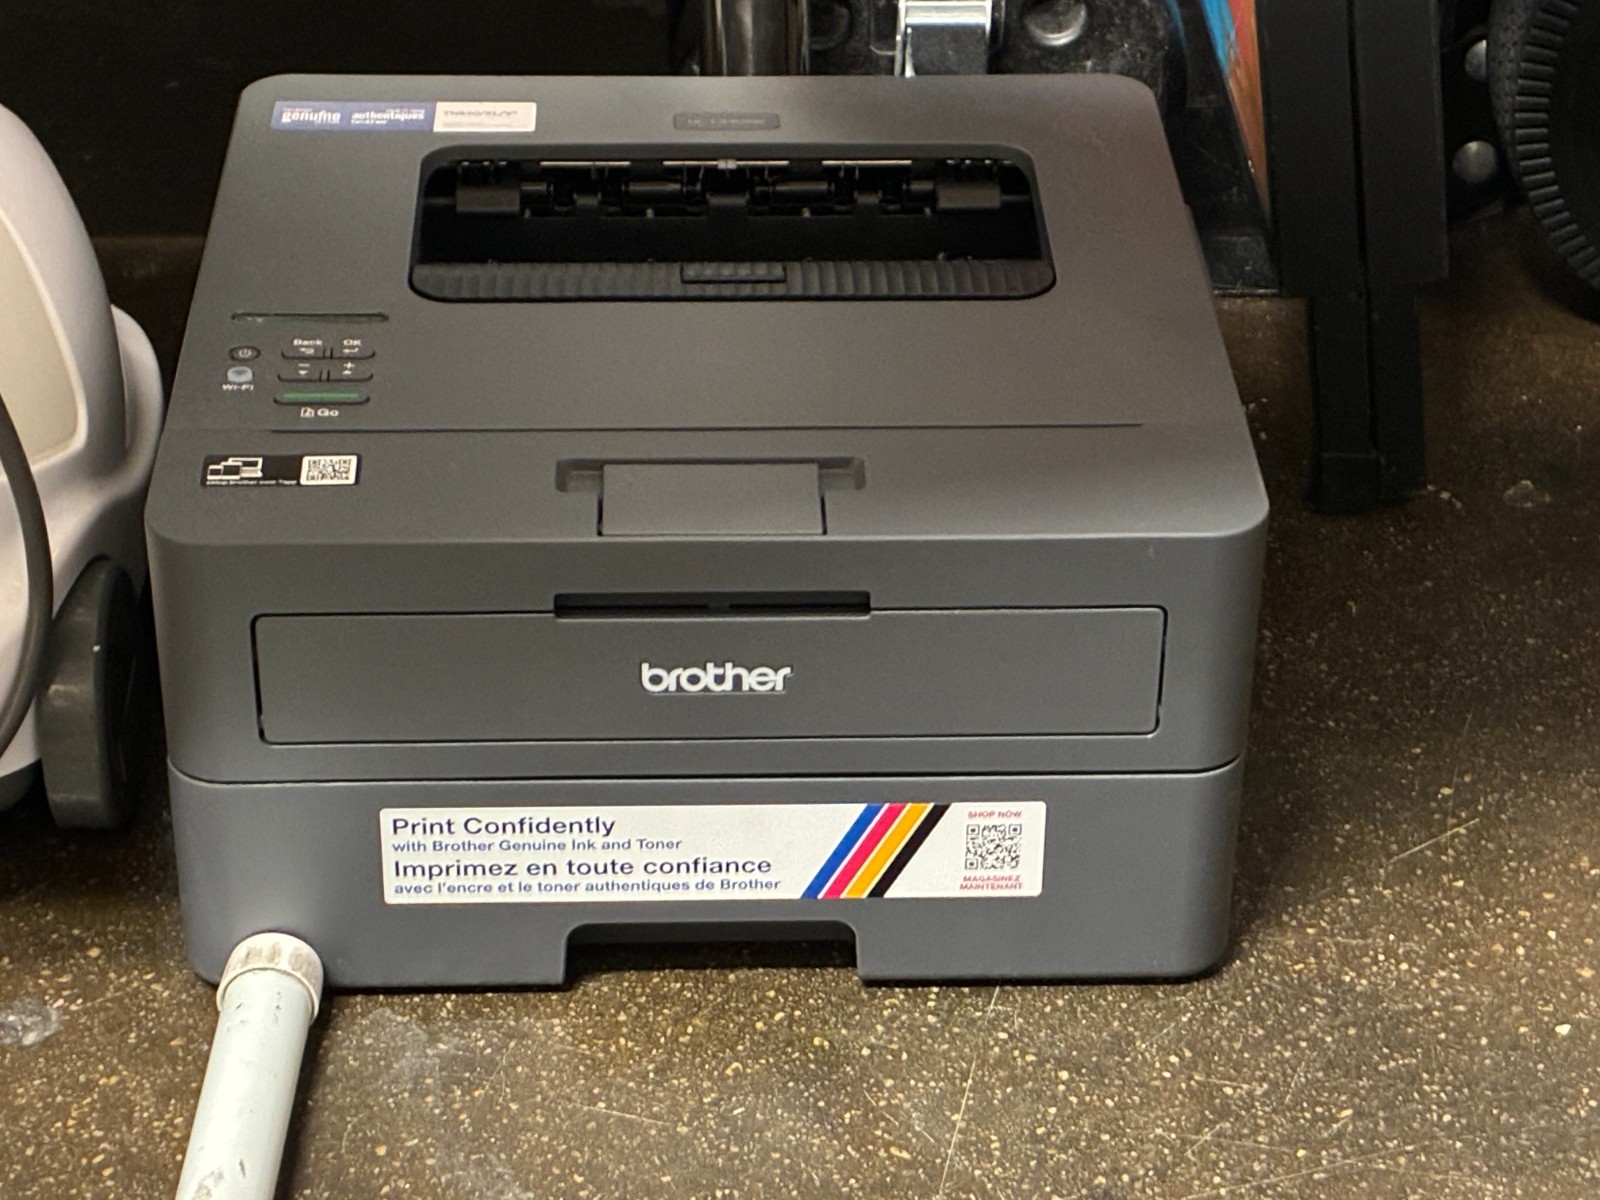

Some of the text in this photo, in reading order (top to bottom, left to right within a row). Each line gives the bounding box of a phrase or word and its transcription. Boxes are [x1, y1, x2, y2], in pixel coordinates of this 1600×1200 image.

[343, 338, 362, 346] OK
[222, 383, 254, 391] Wi-Fi
[317, 407, 339, 417] Go
[640, 661, 793, 693] brother
[968, 810, 1022, 819] SHOP NOW
[392, 816, 616, 837] Print Confidently
[392, 838, 683, 852] with Brother Genuine Ink and Toner
[394, 856, 772, 880] Imprimez en toute confiance
[394, 878, 781, 894] avec l'encre et le toner authentiques de Brother
